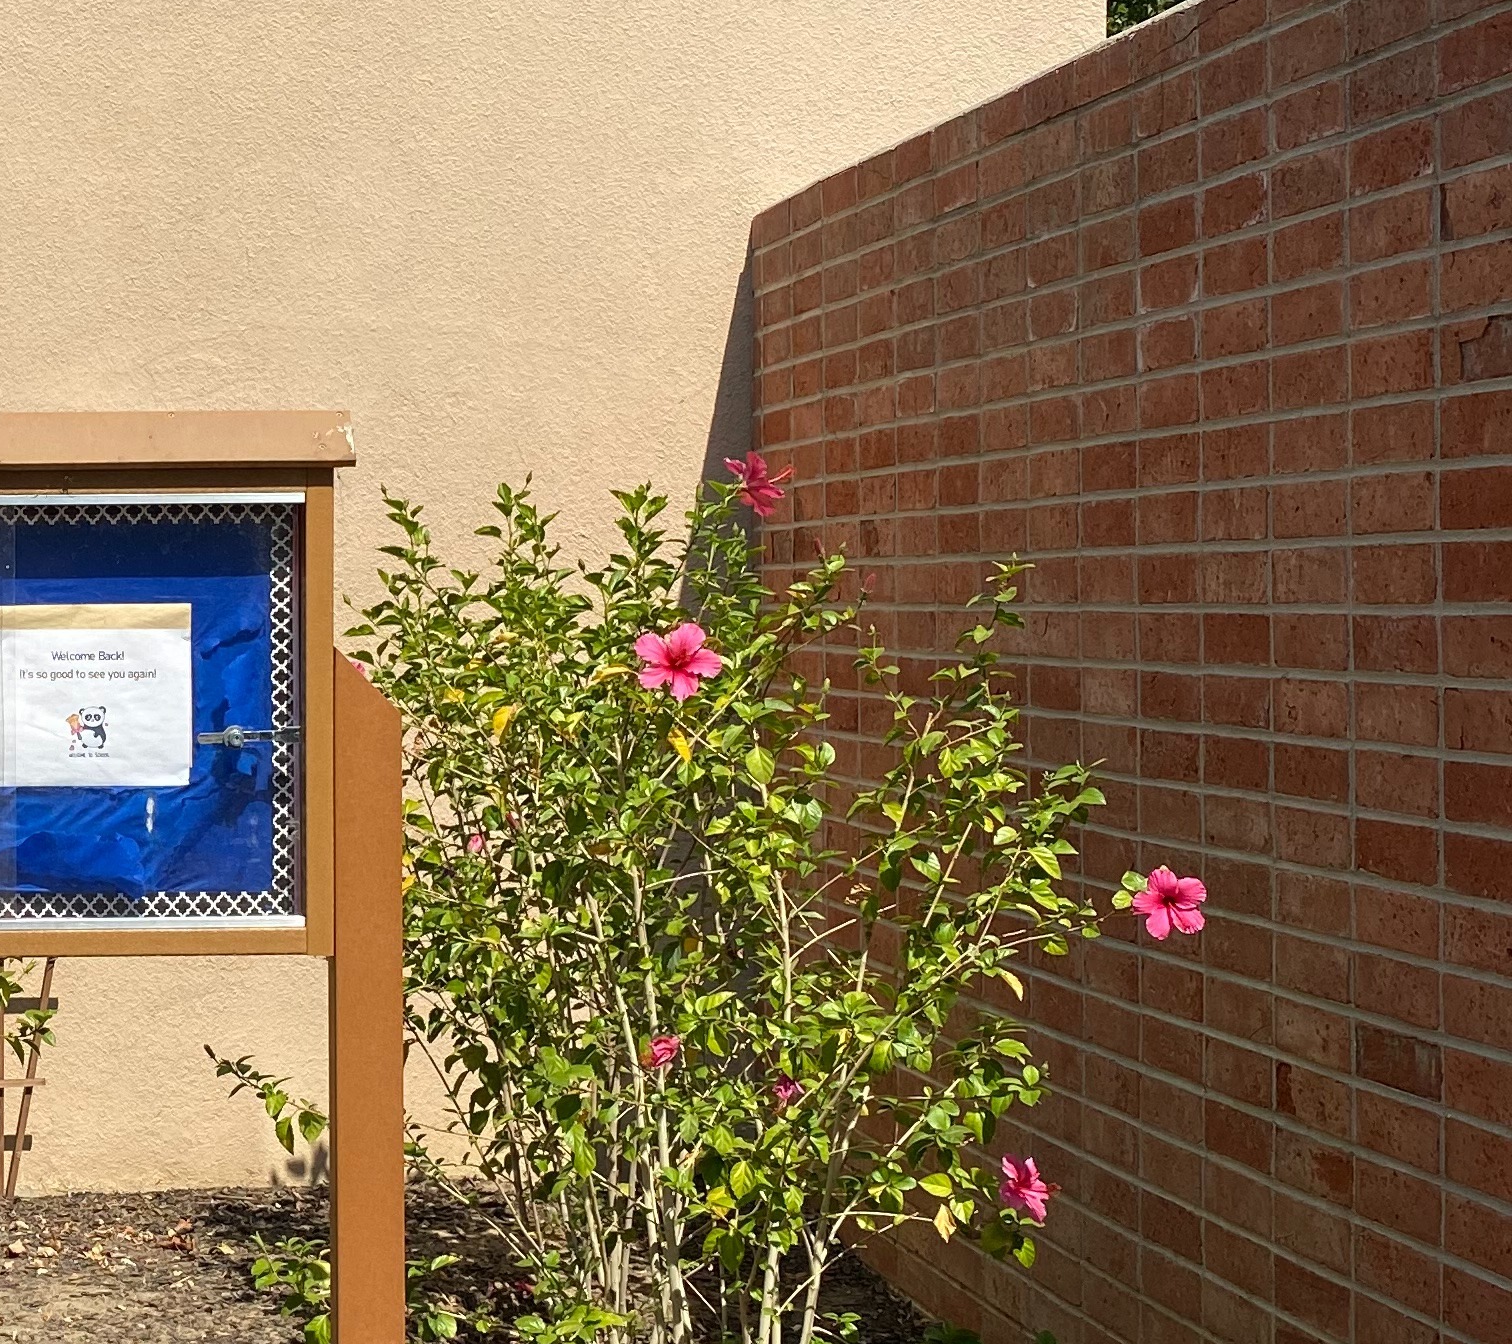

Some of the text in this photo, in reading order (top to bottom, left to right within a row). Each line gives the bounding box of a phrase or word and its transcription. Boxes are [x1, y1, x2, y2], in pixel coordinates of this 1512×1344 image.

[51, 650, 125, 661] Welcome Back!
[19, 668, 157, 682] It's so good to see you again!
